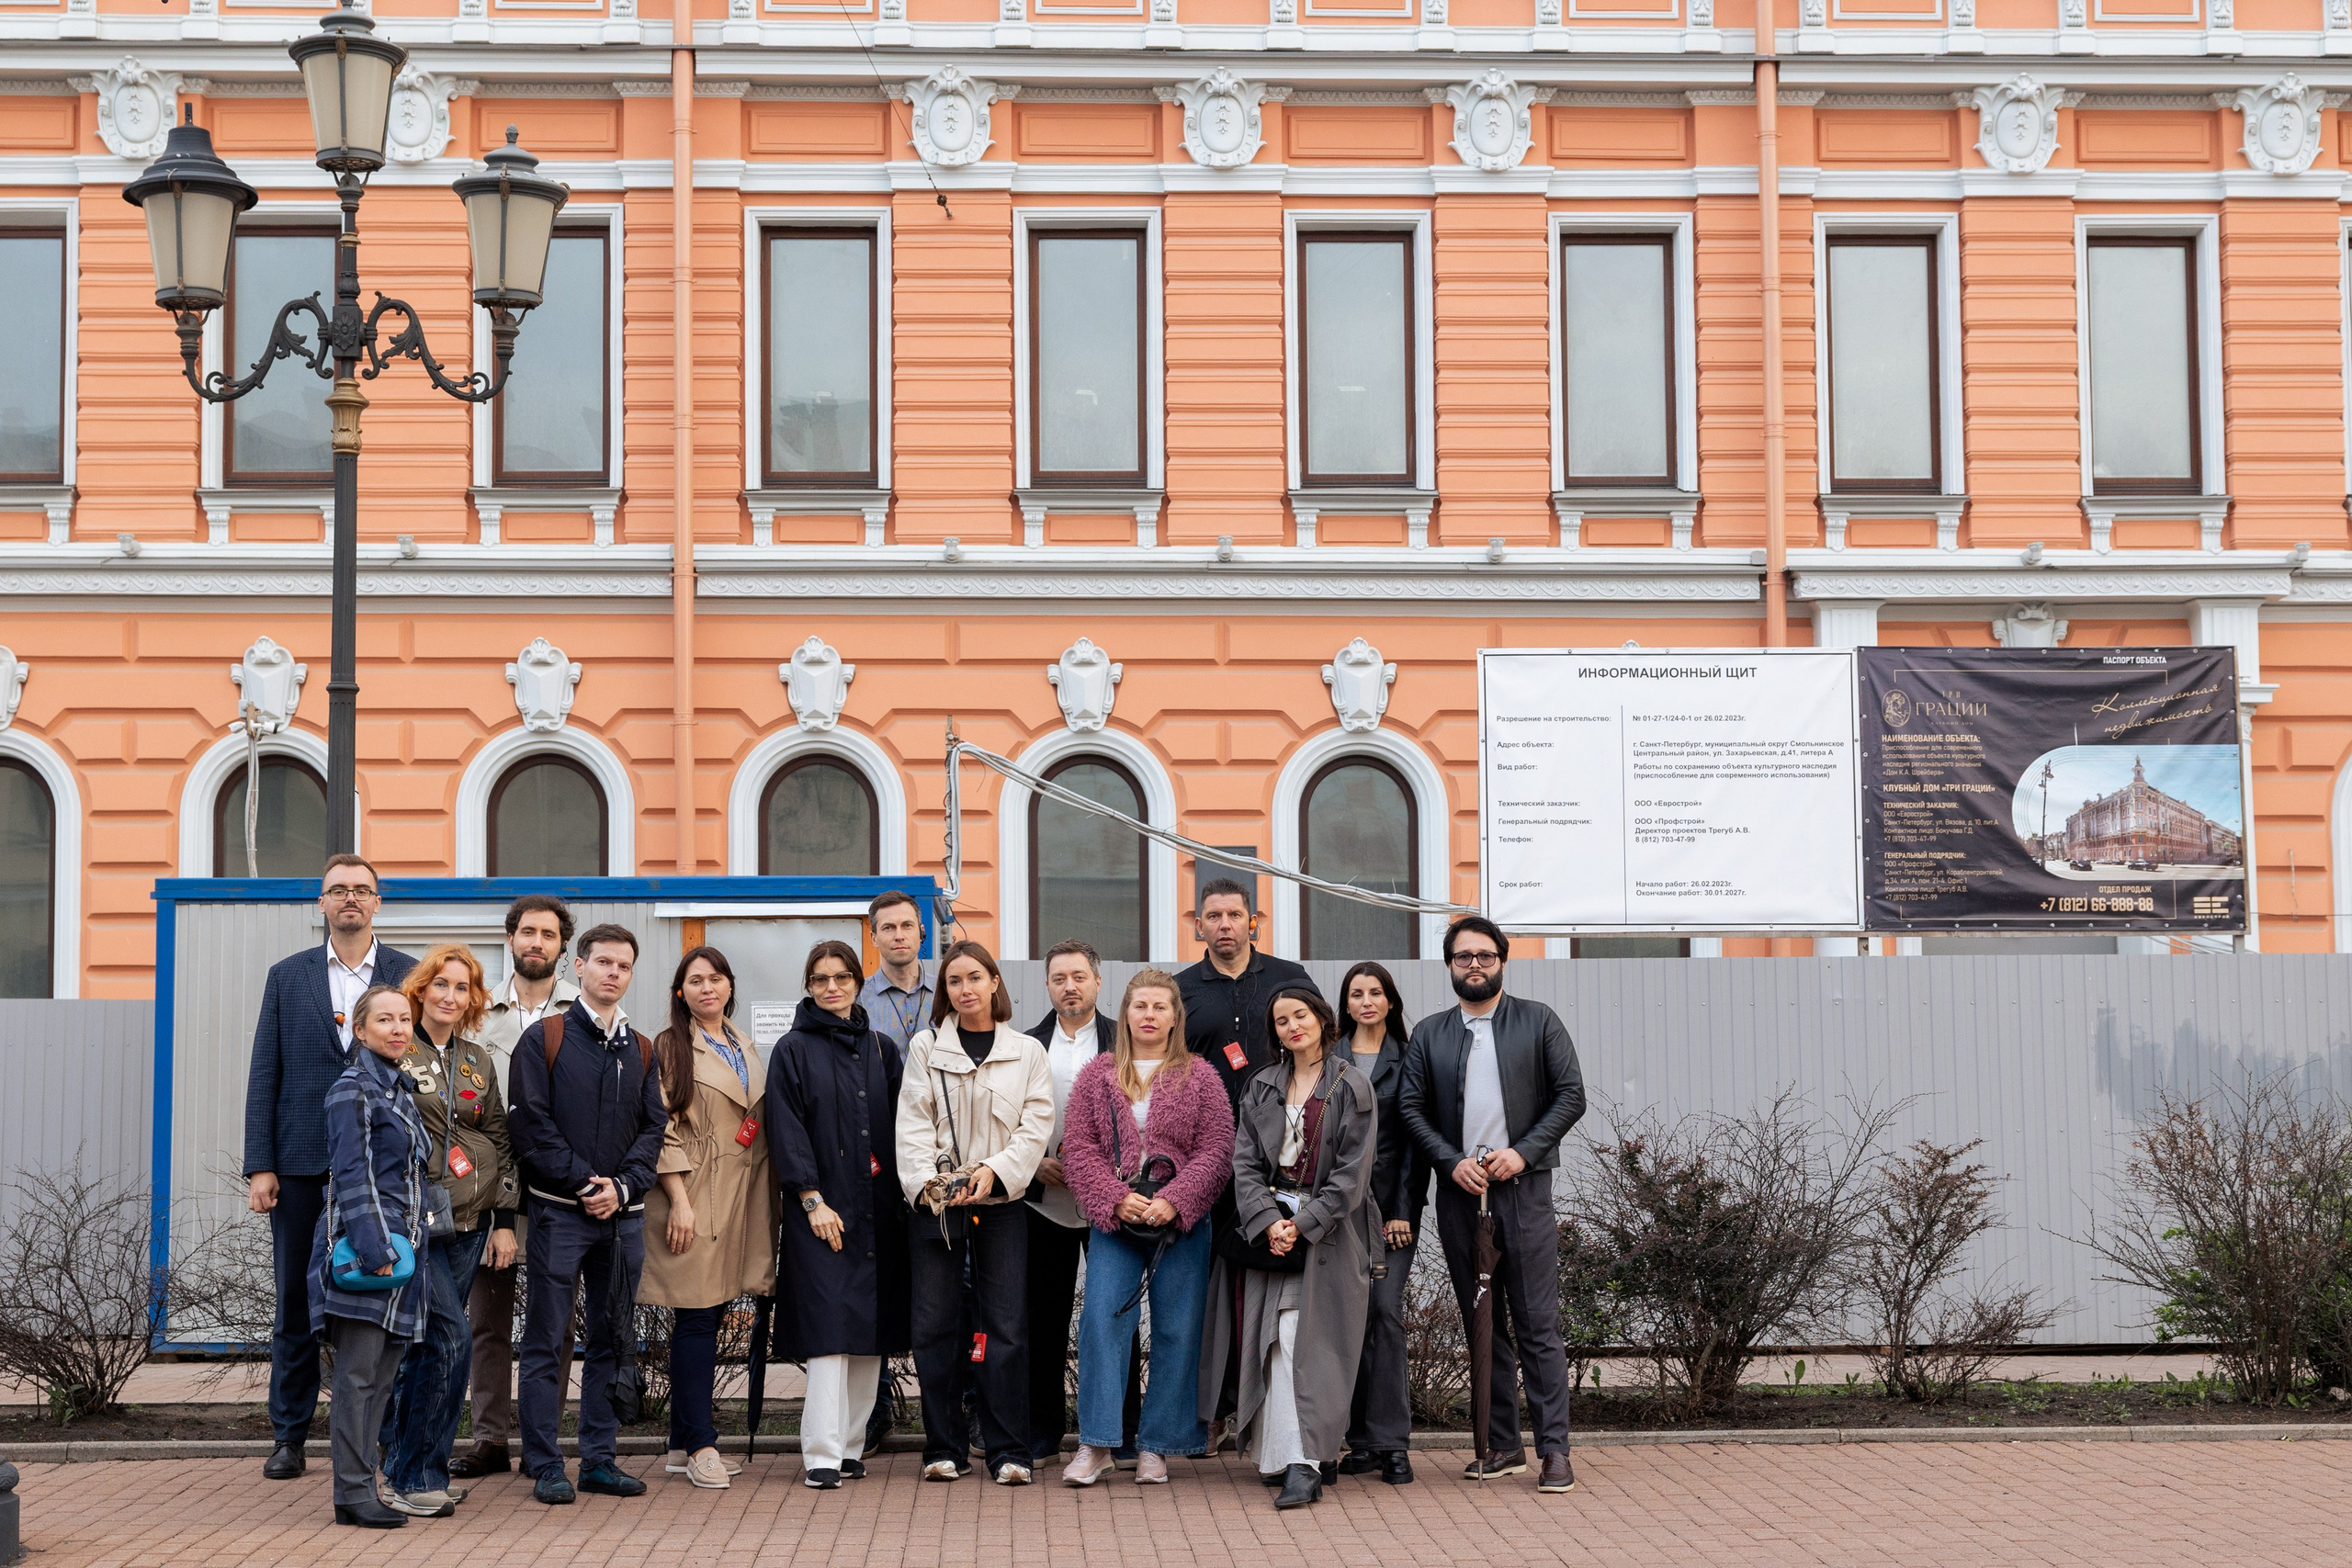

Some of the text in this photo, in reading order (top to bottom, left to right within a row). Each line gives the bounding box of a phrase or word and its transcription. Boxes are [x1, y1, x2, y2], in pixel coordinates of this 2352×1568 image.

[2103, 656, 2167, 664] ПАСПОРТ ОБЪЕКТА
[1578, 665, 1757, 680] ИНФОРМАЦИОННЫЙ ЩИТ
[2091, 683, 2221, 719] Коллекционная
[1916, 702, 1987, 717] ГРАЦИИ
[2104, 705, 2213, 740] недвижимость
[1882, 734, 1980, 742] НАИМЕНОВАНИЕ ОБЪЕКТА:
[1639, 740, 1703, 749] Санкт-Петербург,
[1634, 750, 1685, 758] Центральный
[1634, 772, 1698, 780] (приспособление
[1883, 783, 1996, 794] КЛУБНЫЙ ДОМ «ТРИ ГРАЦИИ»
[1655, 818, 1705, 826] «Профстрой»
[1708, 827, 1734, 835] Трегуб
[1641, 836, 1659, 844] (812)
[1679, 889, 1702, 897] работ:
[2098, 886, 2152, 894] ОТДЕЛ ПРОДАЖ
[2041, 897, 2154, 911] +7 (812) 66-888-88
[409, 1065, 437, 1095] 5
